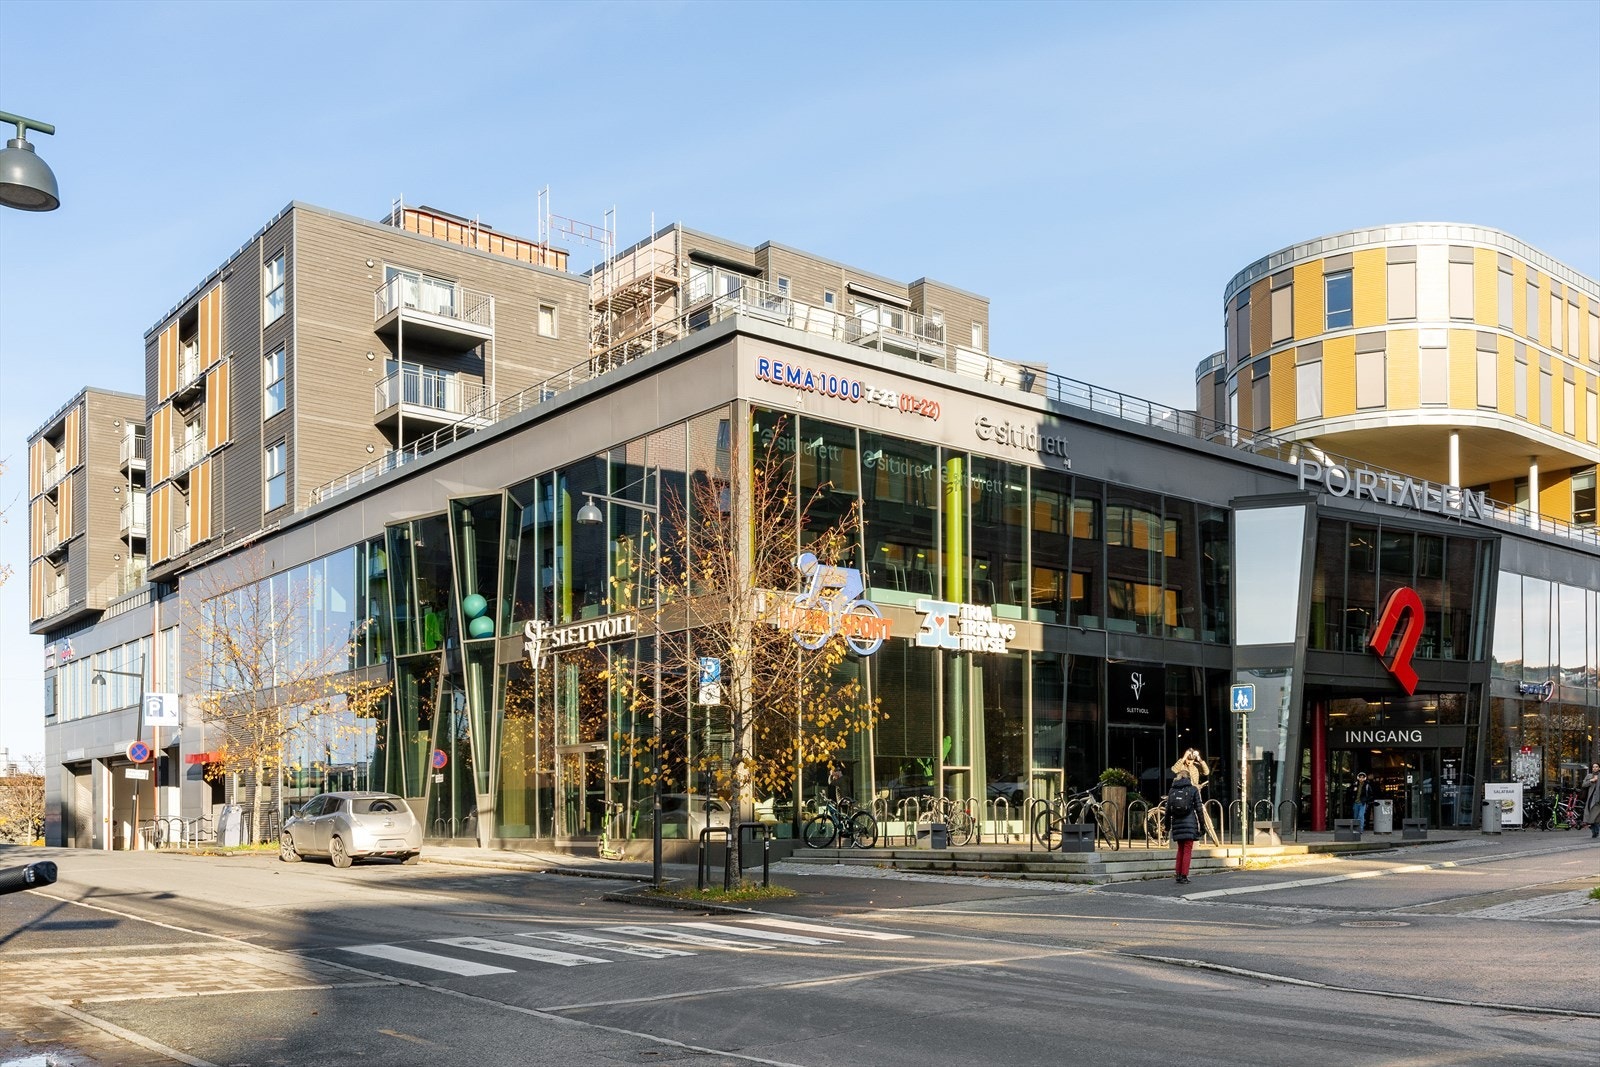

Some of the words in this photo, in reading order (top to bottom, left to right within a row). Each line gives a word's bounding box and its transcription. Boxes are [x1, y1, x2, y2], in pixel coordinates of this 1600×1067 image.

[757, 356, 816, 391] REMA
[819, 371, 862, 401] 1000
[865, 385, 899, 406] 7-23
[900, 393, 941, 420] (11-22)
[1298, 458, 1485, 520] PORTALEN
[960, 603, 993, 622] TRIM
[551, 615, 637, 649] SLETTVOLL
[840, 613, 894, 640] SPORT
[960, 619, 1016, 641] TRENING
[960, 634, 1009, 654] TRIVSEL
[1345, 729, 1423, 743] INNGANG
